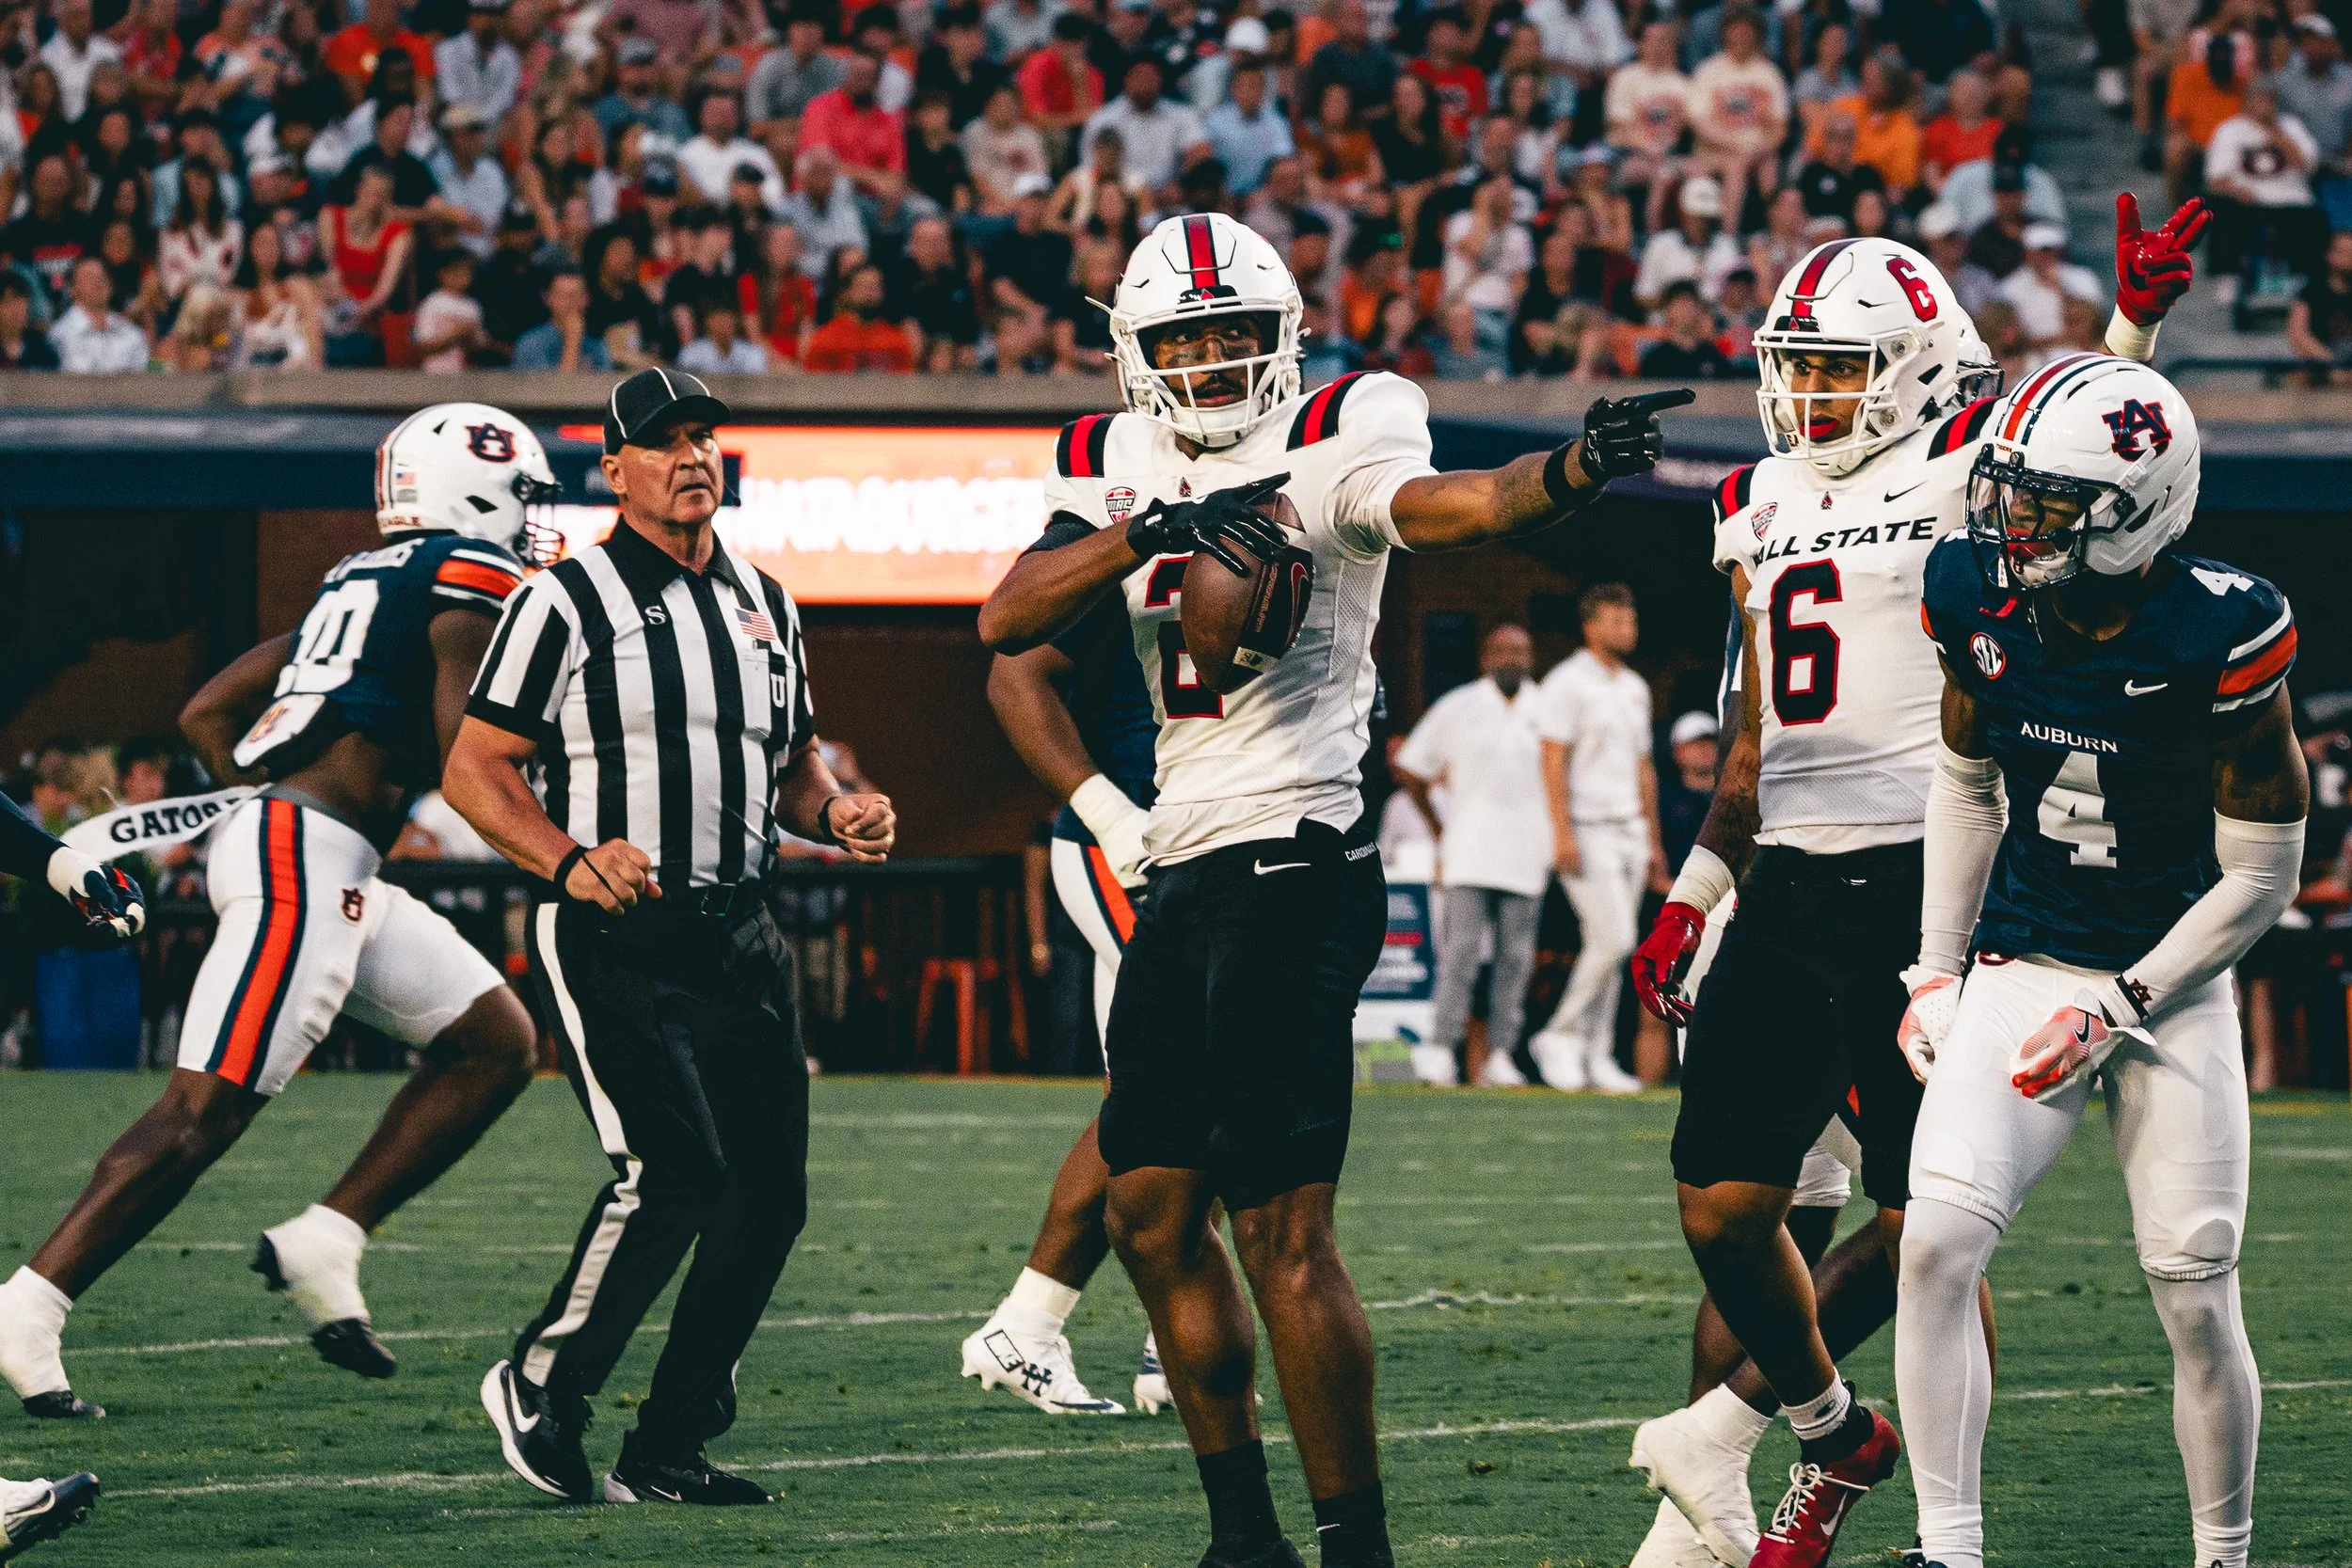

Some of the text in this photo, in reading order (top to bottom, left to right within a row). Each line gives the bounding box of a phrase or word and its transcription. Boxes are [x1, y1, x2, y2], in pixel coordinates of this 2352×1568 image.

[1886, 257, 1937, 323] 6
[1810, 516, 1938, 553] STATE
[1769, 558, 1843, 727] 6
[1972, 636, 2003, 676] SEC
[771, 673, 786, 708] U
[2021, 721, 2118, 752] AUBURN
[2037, 751, 2117, 868] 4
